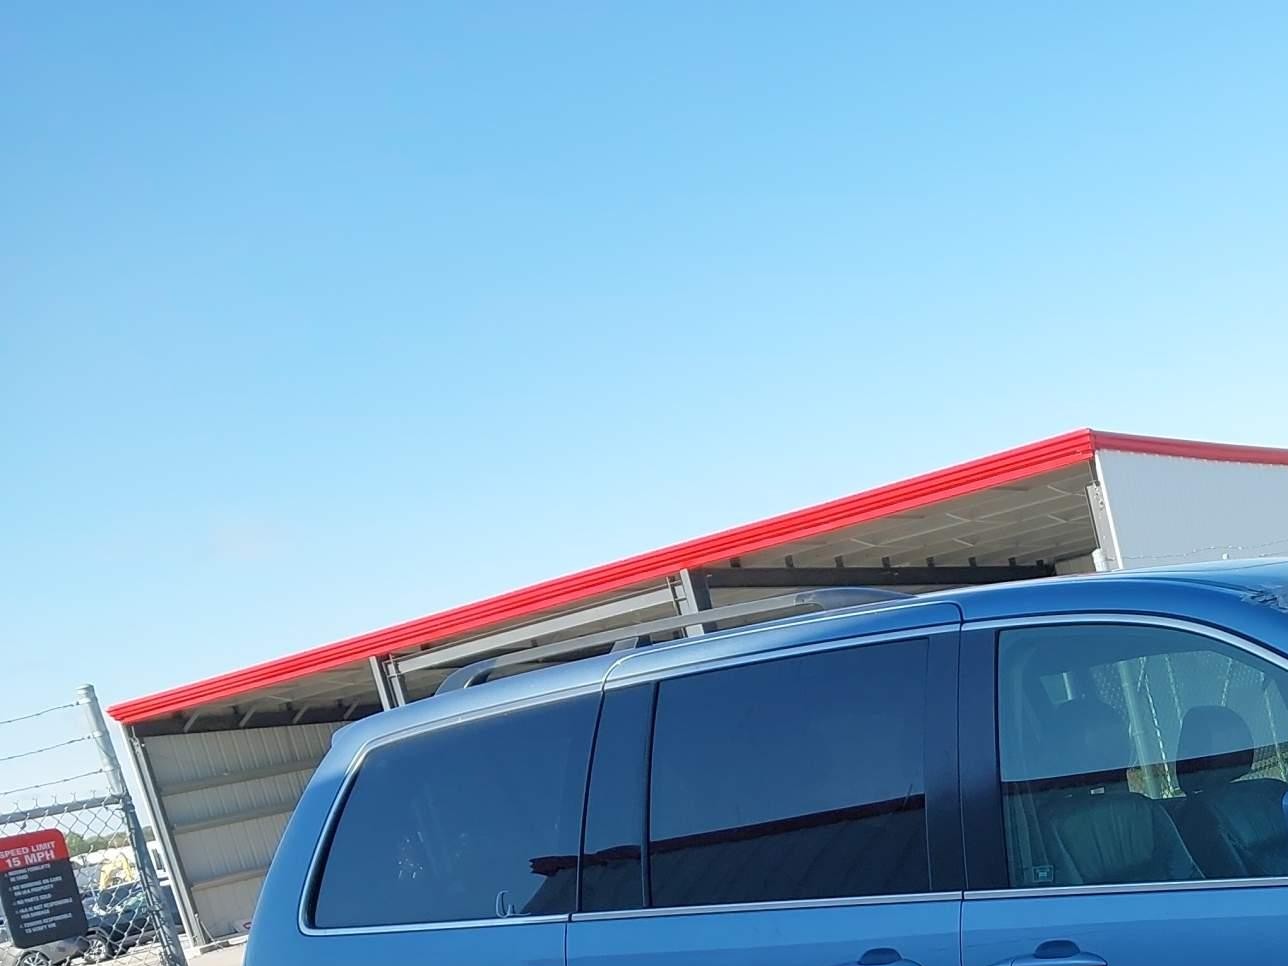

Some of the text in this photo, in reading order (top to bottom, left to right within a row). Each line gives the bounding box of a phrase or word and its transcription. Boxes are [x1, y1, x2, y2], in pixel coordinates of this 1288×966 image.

[0, 841, 56, 859] SPEED LIMIT
[6, 849, 55, 868] 15 MPH
